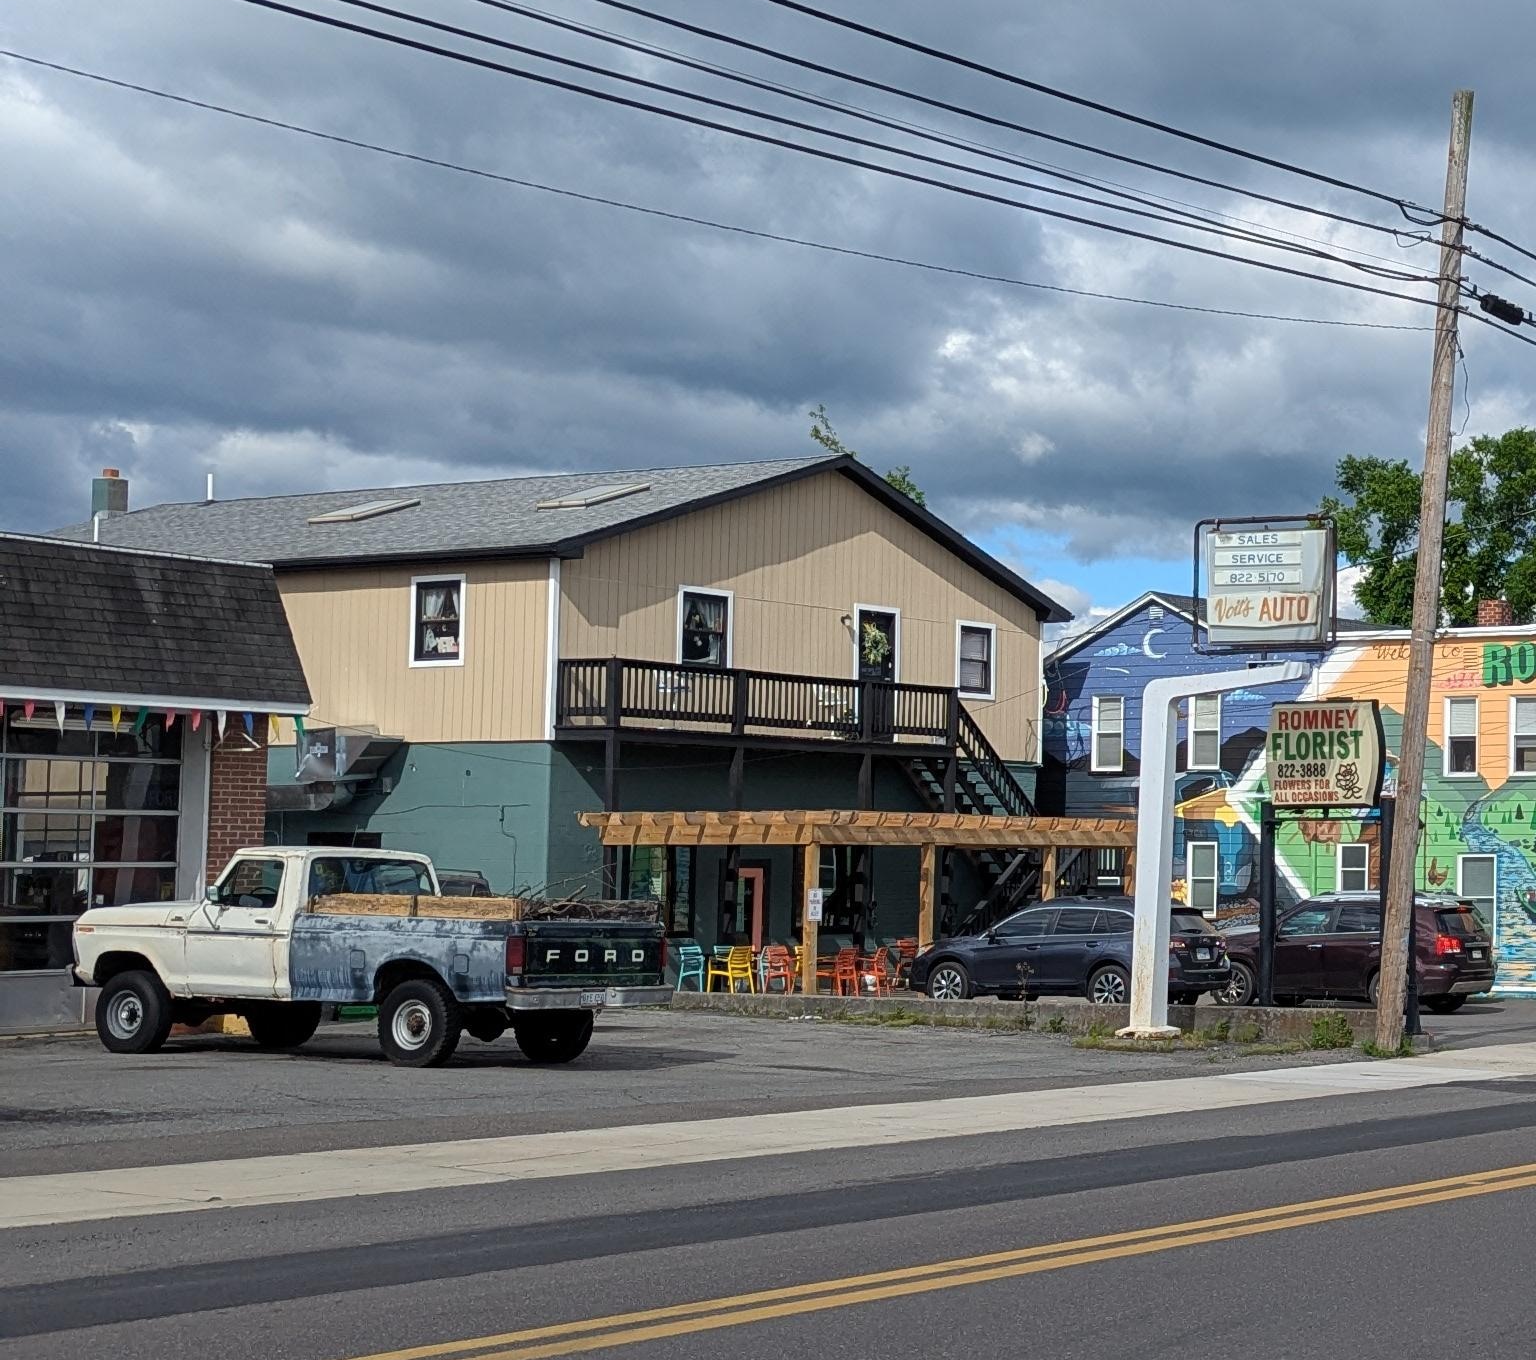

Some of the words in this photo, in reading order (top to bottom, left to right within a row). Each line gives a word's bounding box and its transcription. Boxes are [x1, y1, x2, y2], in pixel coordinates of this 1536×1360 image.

[1238, 534, 1278, 545] SALES
[1231, 553, 1284, 564] SERVICE
[1259, 596, 1309, 622] AUTO
[1373, 643, 1411, 660] Welc
[1278, 709, 1358, 731] ROMNEY
[1271, 730, 1363, 761] FLORIST
[1277, 763, 1326, 778] 822-3888
[1274, 780, 1312, 790] FLOWERS
[1314, 779, 1330, 790] FOR
[1274, 792, 1290, 803] ALL
[1291, 791, 1340, 802] OCCASIONS
[546, 949, 644, 962] FORD
